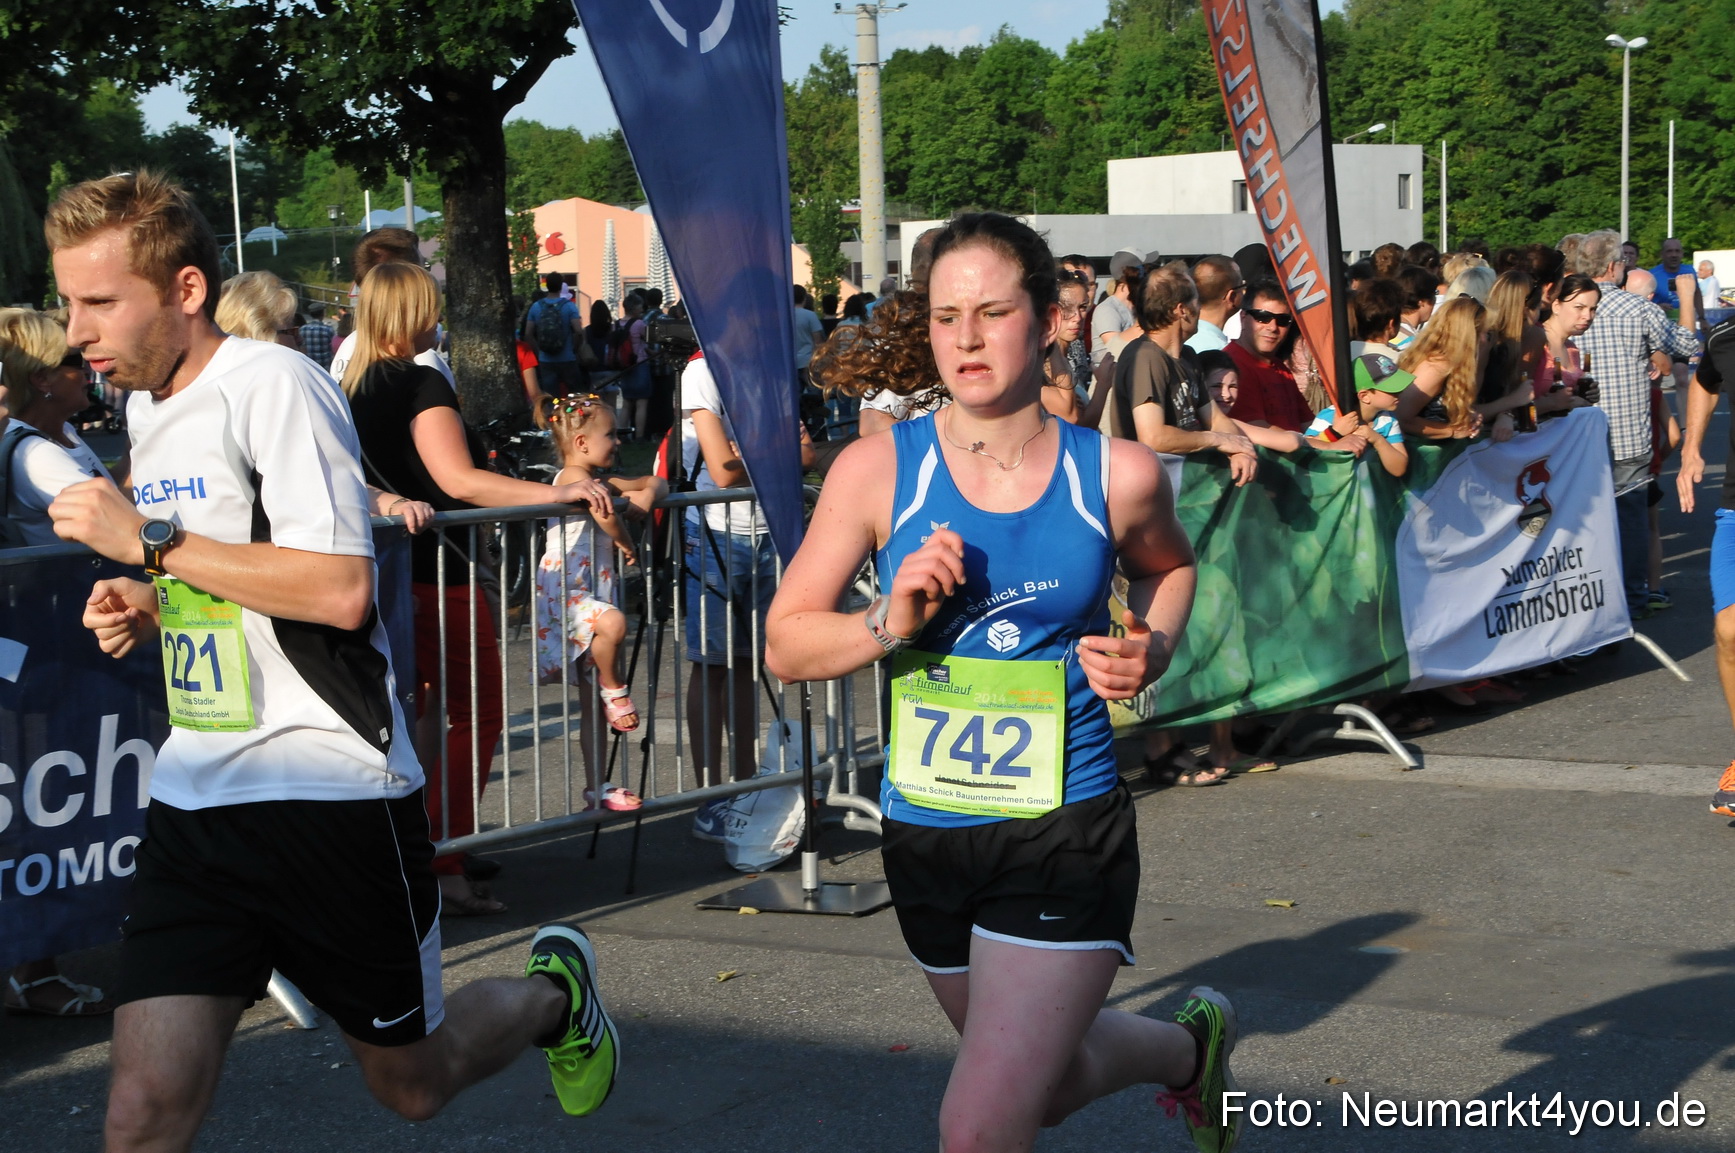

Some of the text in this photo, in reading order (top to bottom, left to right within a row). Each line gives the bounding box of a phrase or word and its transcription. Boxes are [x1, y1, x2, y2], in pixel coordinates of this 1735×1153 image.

[133, 477, 206, 505] DELPHI
[938, 578, 1059, 640] Team Schick Bau
[1484, 573, 1605, 639] Lammsbräu
[164, 631, 224, 692] 221
[916, 677, 973, 696] firmenlauf
[973, 692, 1006, 704] 2014
[193, 697, 216, 706] Stadler
[211, 711, 230, 719] GmbH
[914, 706, 1033, 778] 742
[0, 713, 157, 833] ch
[895, 780, 1053, 806] Matthias Schick Bauunternehmen GmbH
